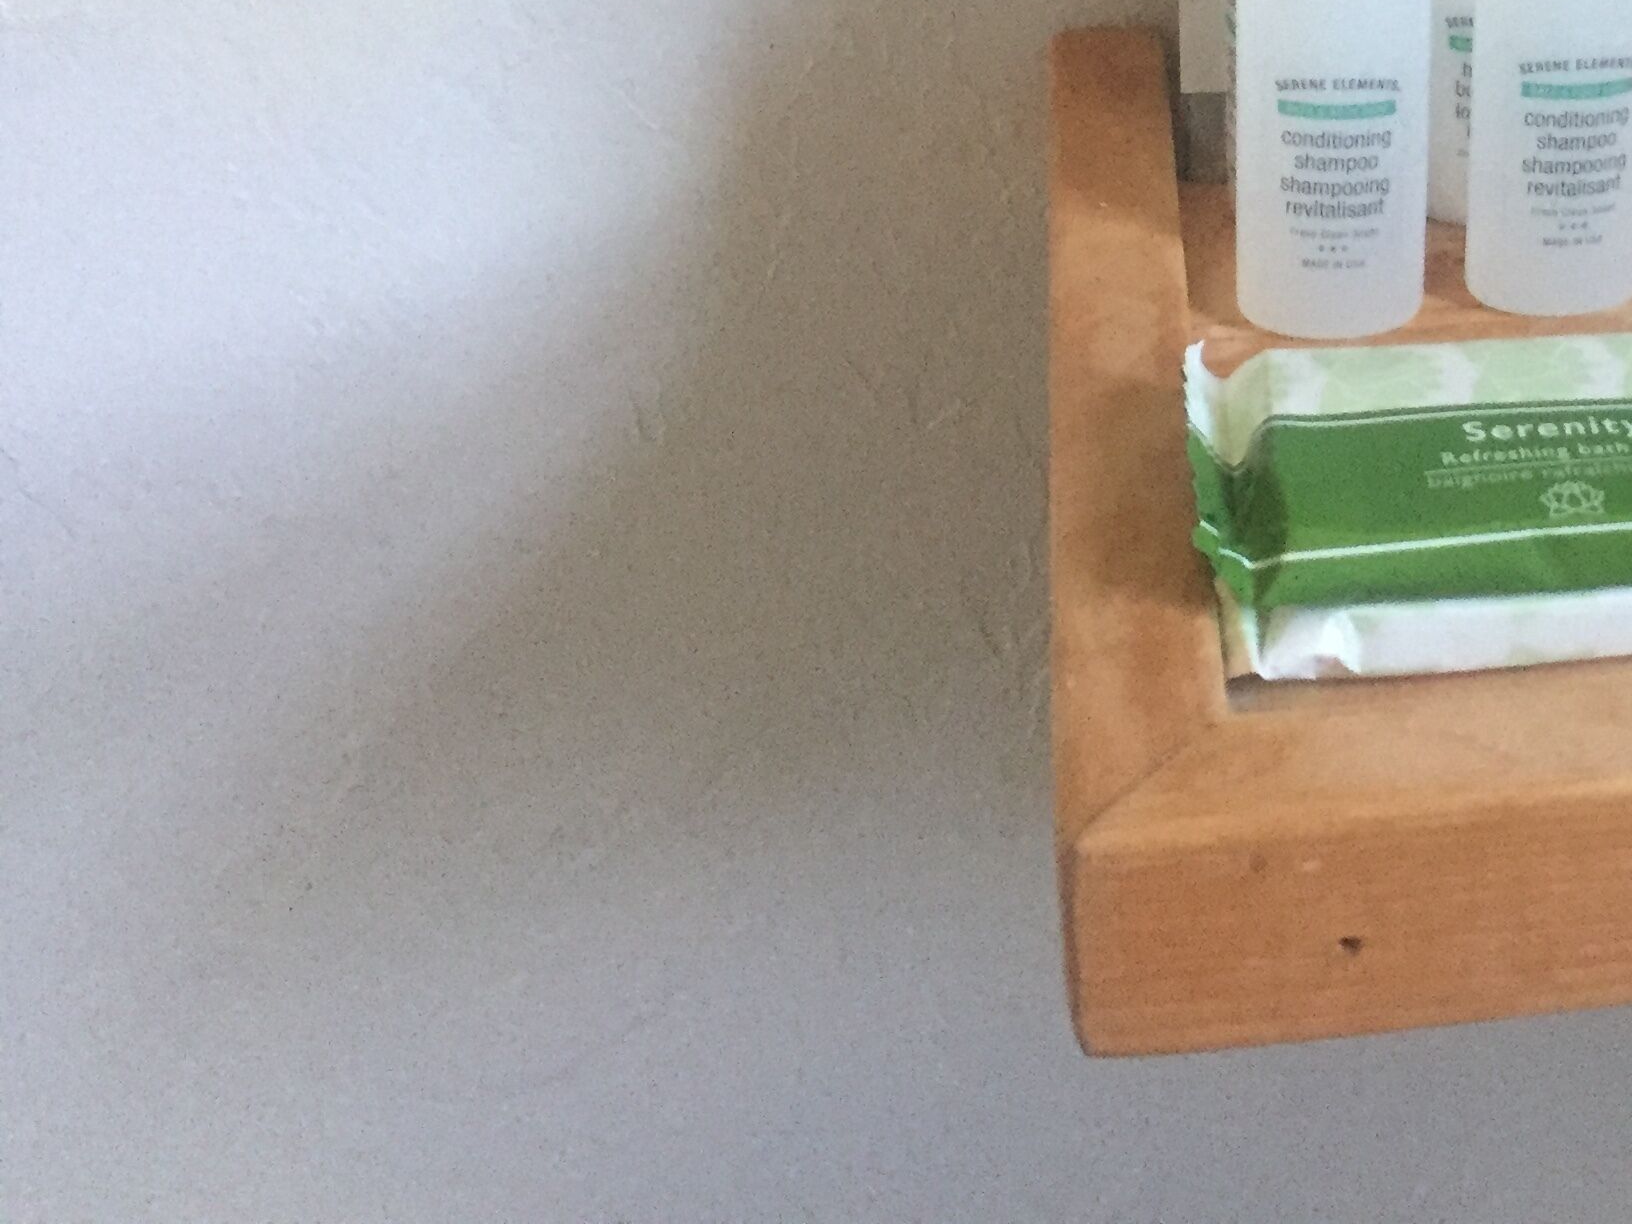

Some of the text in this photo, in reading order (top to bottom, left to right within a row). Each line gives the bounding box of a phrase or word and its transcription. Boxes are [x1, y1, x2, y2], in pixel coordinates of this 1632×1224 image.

[1518, 59, 1569, 74] SERENE
[1274, 78, 1326, 92] SERENE
[1523, 107, 1630, 129] conditioning
[1280, 129, 1392, 150] conditioning
[1535, 131, 1617, 152] shampoo
[1293, 152, 1379, 175] shampoo
[1521, 153, 1627, 176] shampooing
[1279, 175, 1391, 198] shampooing
[1526, 174, 1622, 197] revitalisant
[1285, 197, 1385, 218] revitalisant
[1439, 447, 1570, 466] Refreshing
[1577, 442, 1631, 457] bath
